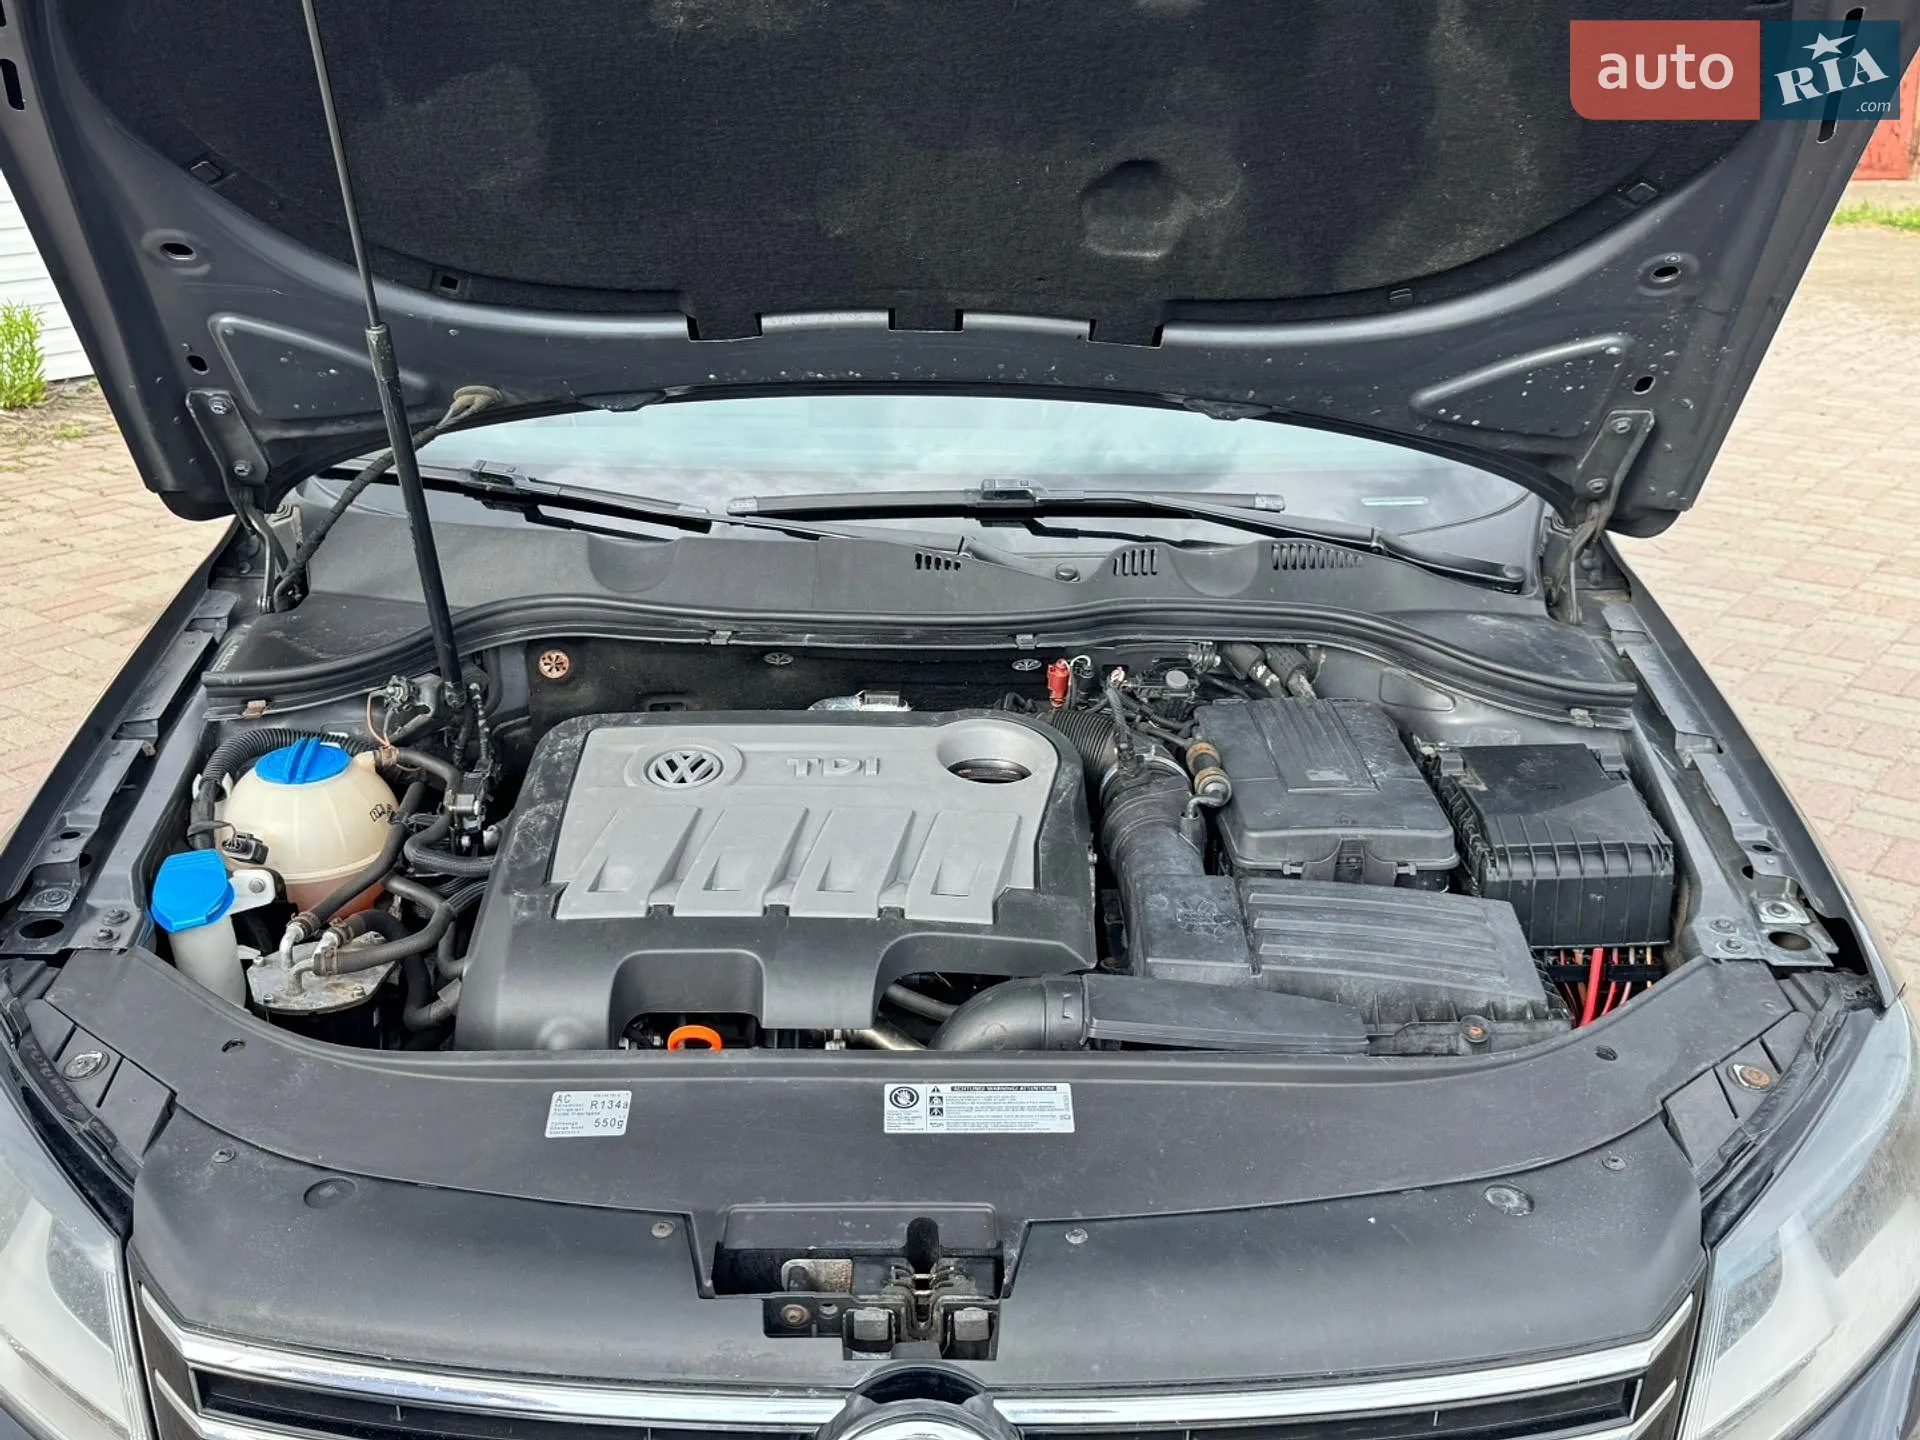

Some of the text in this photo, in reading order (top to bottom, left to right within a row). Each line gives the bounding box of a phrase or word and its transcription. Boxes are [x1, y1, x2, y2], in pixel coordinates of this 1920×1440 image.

[786, 757, 881, 777] TDI
[555, 1093, 571, 1103] AC
[590, 1100, 628, 1109] R134a
[593, 1117, 624, 1128] 550g
